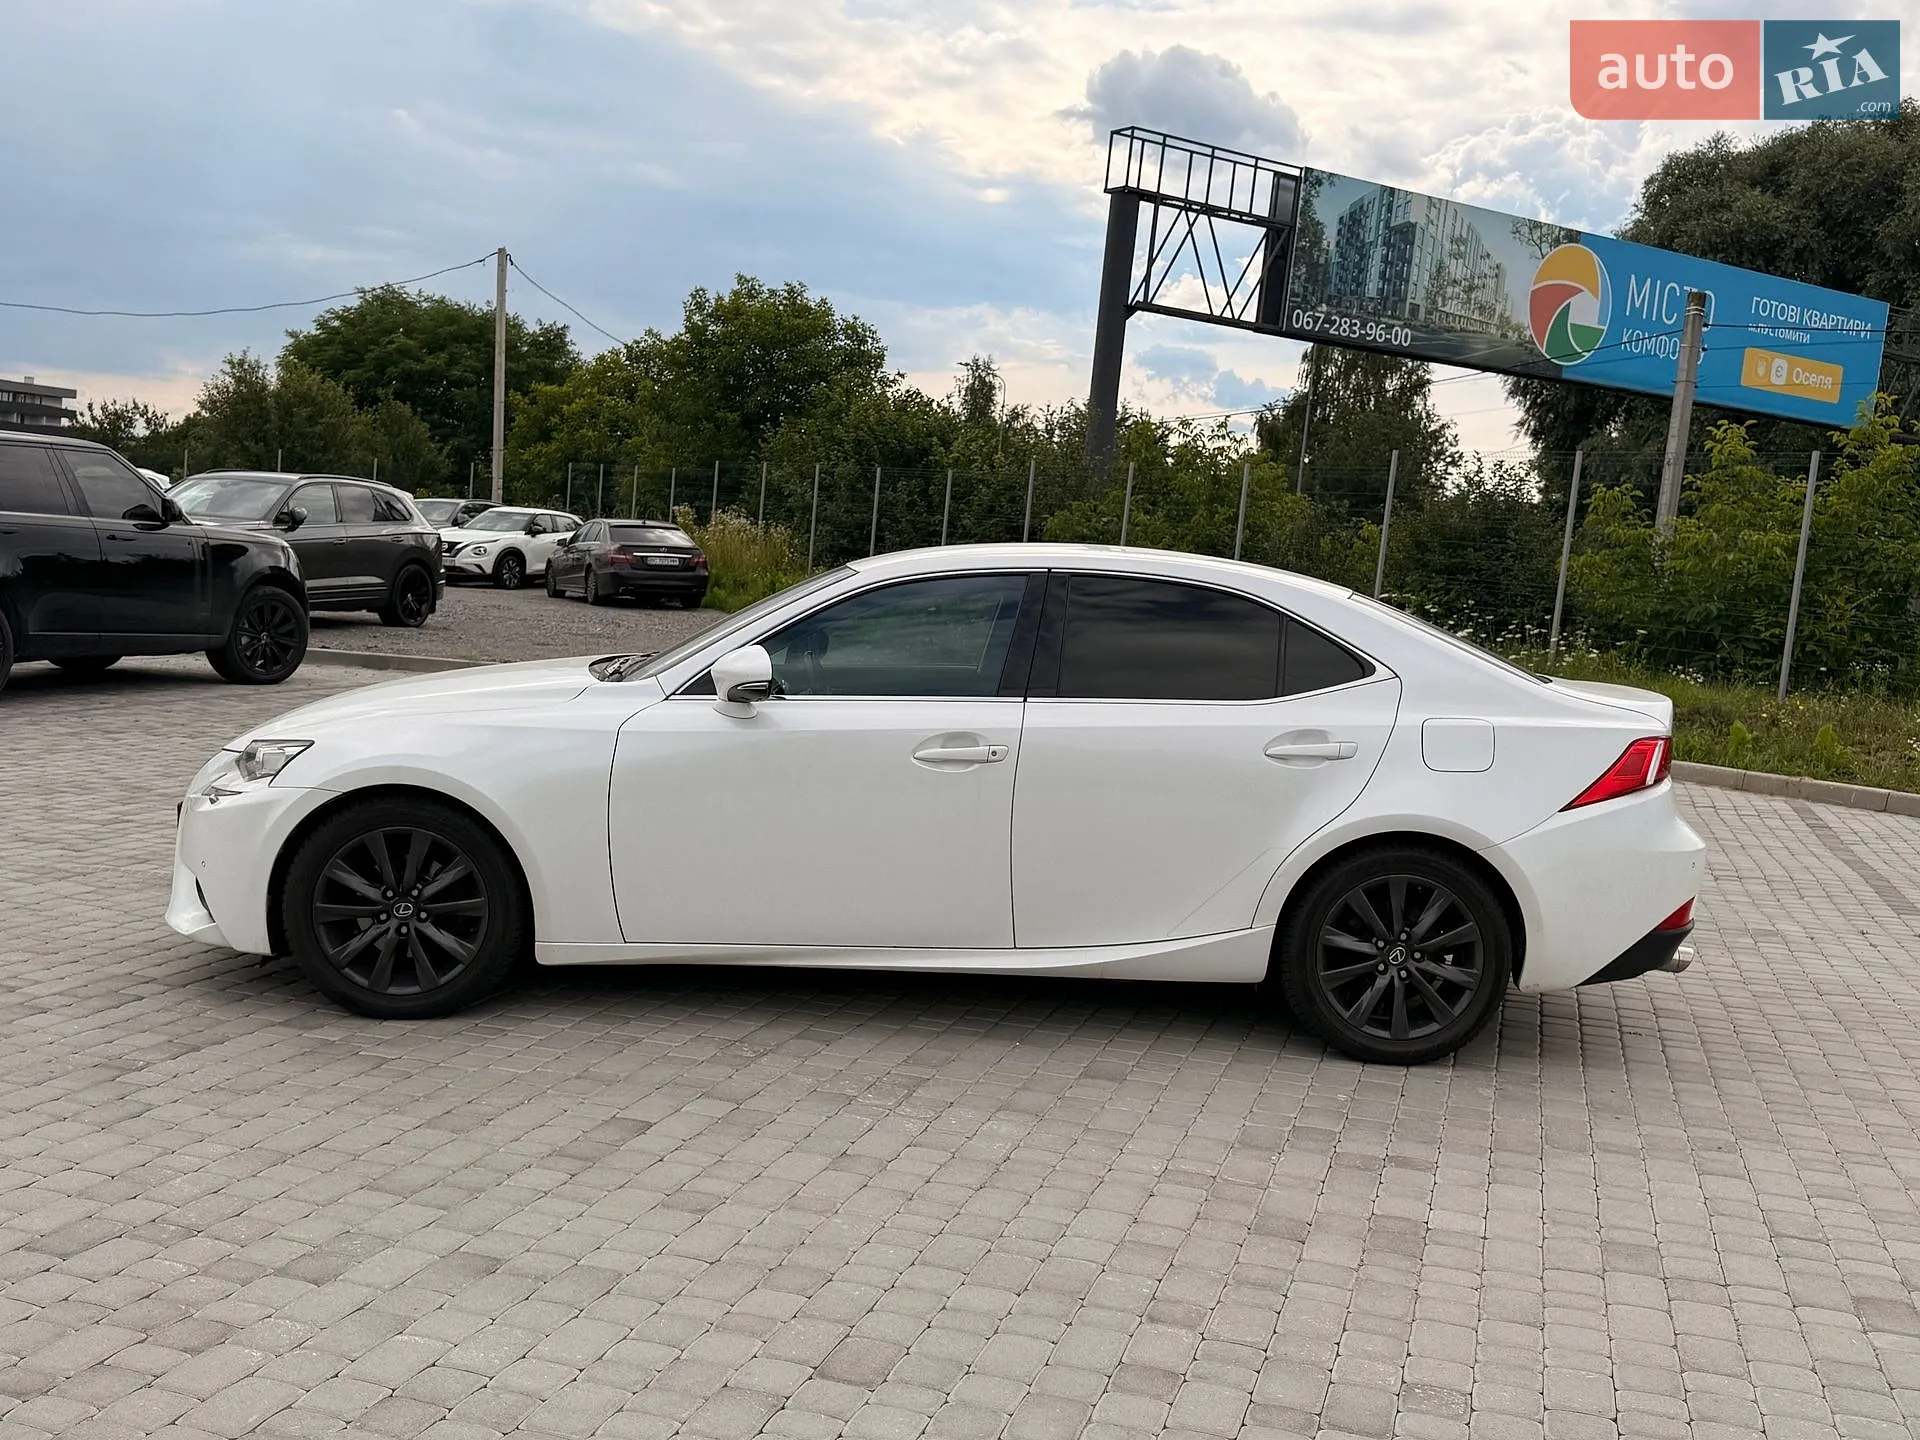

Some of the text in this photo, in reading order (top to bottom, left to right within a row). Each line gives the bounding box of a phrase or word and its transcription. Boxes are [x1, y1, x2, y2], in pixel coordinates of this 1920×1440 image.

[1292, 309, 1411, 347] 067-283-96-00
[1751, 296, 1872, 340] ГОТОВІ КВАРТИРИ
[1792, 367, 1833, 390] Оселя
